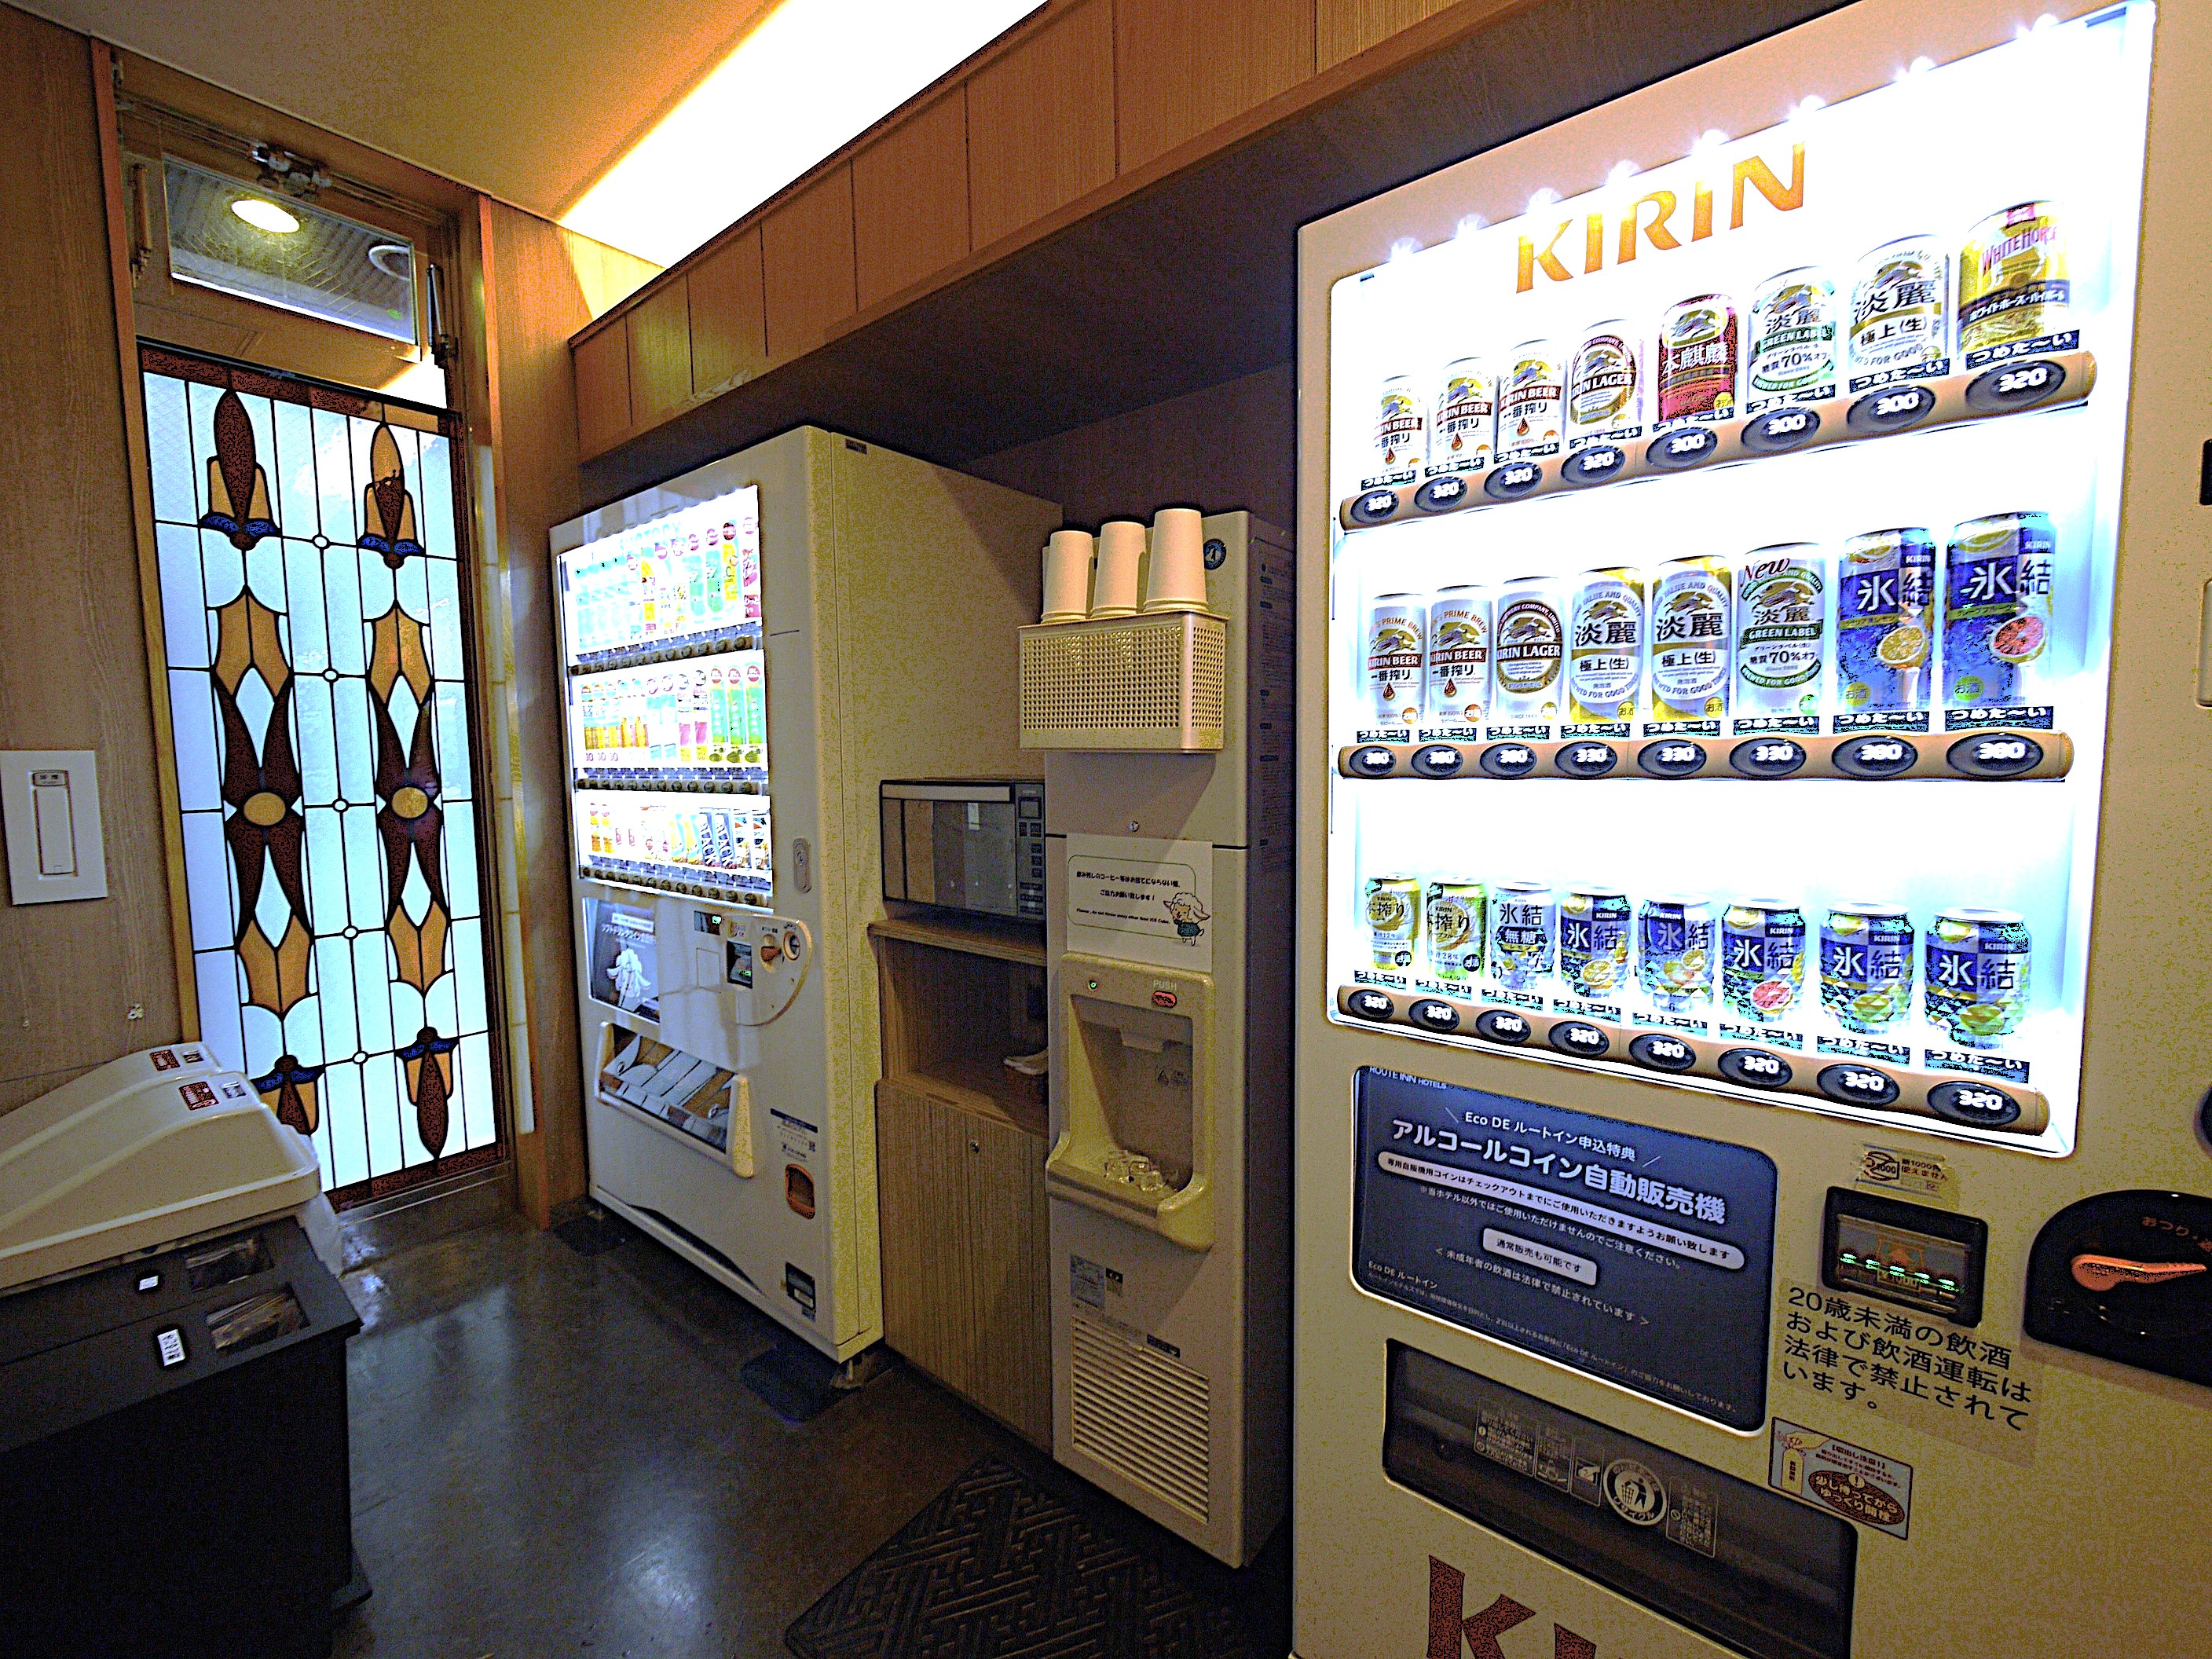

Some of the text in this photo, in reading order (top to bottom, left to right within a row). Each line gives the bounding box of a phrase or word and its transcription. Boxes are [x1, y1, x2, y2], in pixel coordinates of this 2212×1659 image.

[1516, 141, 1806, 294] KIRIN
[1853, 280, 1937, 325] 淡麗
[1662, 342, 1729, 375] 本麒麟
[1591, 373, 1632, 390] LAGER
[1998, 367, 2048, 392] 320
[1529, 385, 1558, 401] BEER
[1460, 401, 1490, 416] BEER
[1502, 401, 1548, 419] 一番搾り
[1877, 393, 1921, 416] 300
[1438, 417, 1481, 435] 一番搾り
[1768, 413, 1807, 435] 300
[1670, 433, 1706, 454] 300
[1740, 558, 1791, 588] New
[1444, 610, 1488, 634] PRIME BREW
[1753, 606, 1811, 626] 淡麗
[1381, 617, 1423, 640] PRIME BREW
[1574, 621, 1638, 648] 淡麗
[1656, 612, 1723, 642] 淡麗
[1749, 627, 1817, 640] GREEN LABEL
[1392, 655, 1419, 666] BEER
[1454, 649, 1484, 661] BEER
[1497, 643, 1561, 661] KIRIN LAGER
[1371, 669, 1412, 683] 一番搾り
[1432, 665, 1474, 678] 一番搾り
[1661, 746, 1696, 763] 330
[1755, 745, 1794, 762] 330
[1500, 903, 1544, 926] 氷結
[1659, 911, 1682, 920] KIRIN
[1504, 928, 1537, 944] 無糖
[1566, 921, 1619, 951] 氷結
[1657, 921, 1709, 950] 氷結
[1769, 926, 1794, 936] KIRIN
[1873, 933, 1901, 943] KIRIN
[1733, 938, 1796, 969] 氷結
[1983, 941, 2014, 951] KIRIN
[1833, 946, 1900, 980] 氷結
[1939, 954, 2017, 991] 氷結
[1152, 980, 1177, 991] PUSH
[1652, 1040, 1685, 1059] 320
[1369, 1066, 1398, 1080] ROUTE
[1399, 1071, 1416, 1084] INN
[1742, 1054, 1780, 1075] 320
[1845, 1071, 1884, 1092] 320
[1957, 1089, 2004, 1111] 320
[1464, 1111, 1637, 1163] Eco DE ルートイン申込特典
[1391, 1119, 1727, 1225] アルコールコイン自動販売機
[1496, 1238, 1583, 1274] 通常販売も可能です
[1397, 1269, 1438, 1290] ルートイン
[1788, 1287, 2012, 1370] 20歳未満の飲酒
[1786, 1312, 2032, 1404] および飲酒運転は
[1783, 1361, 1877, 1410] います。
[1784, 1335, 2030, 1432] 法律で禁止されて
